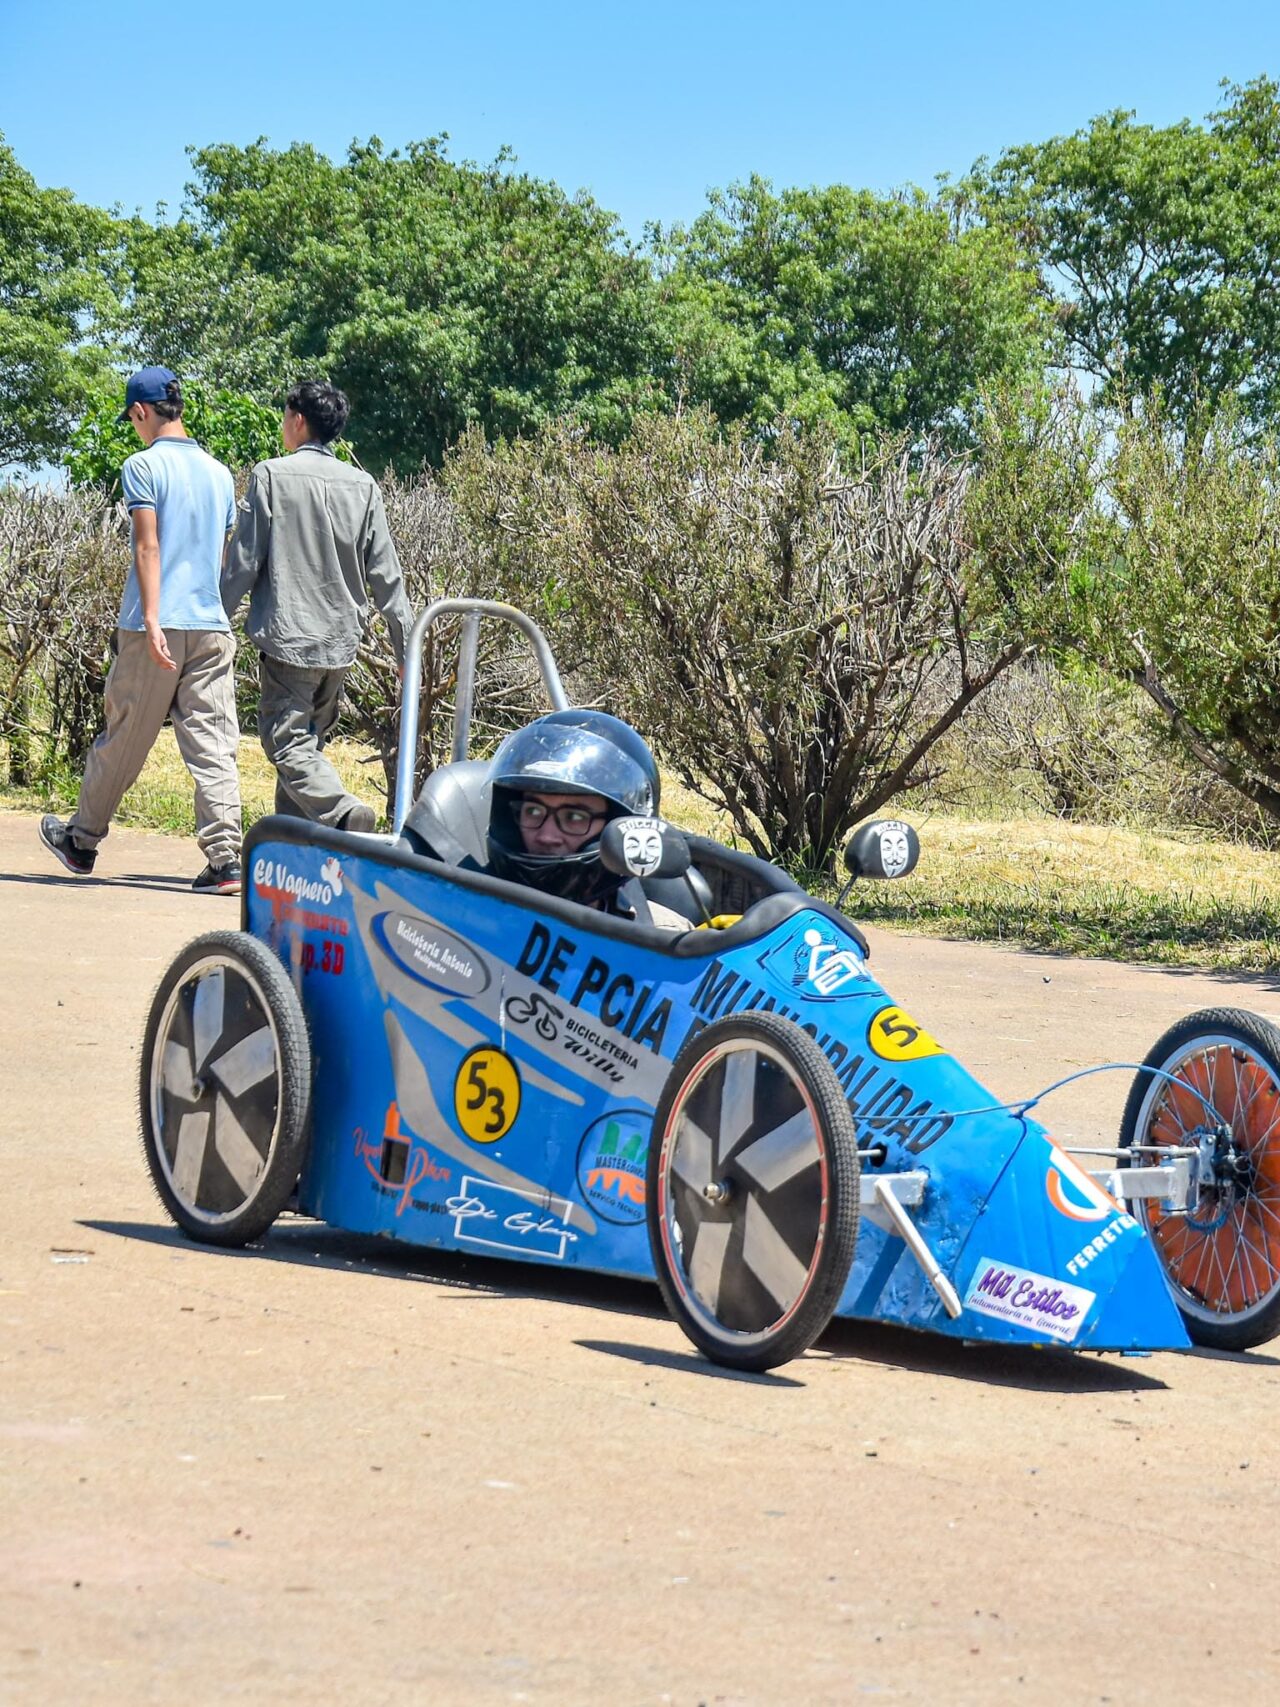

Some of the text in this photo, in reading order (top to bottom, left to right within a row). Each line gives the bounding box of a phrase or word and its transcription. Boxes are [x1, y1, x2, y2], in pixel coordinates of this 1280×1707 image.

[253, 858, 332, 905] El Vaquero
[515, 920, 577, 994] DE
[570, 956, 672, 1055] PCIA
[565, 1018, 639, 1070] BICICLETERIA
[689, 958, 955, 1156] MUPALIDAD
[466, 1060, 507, 1134] 53
